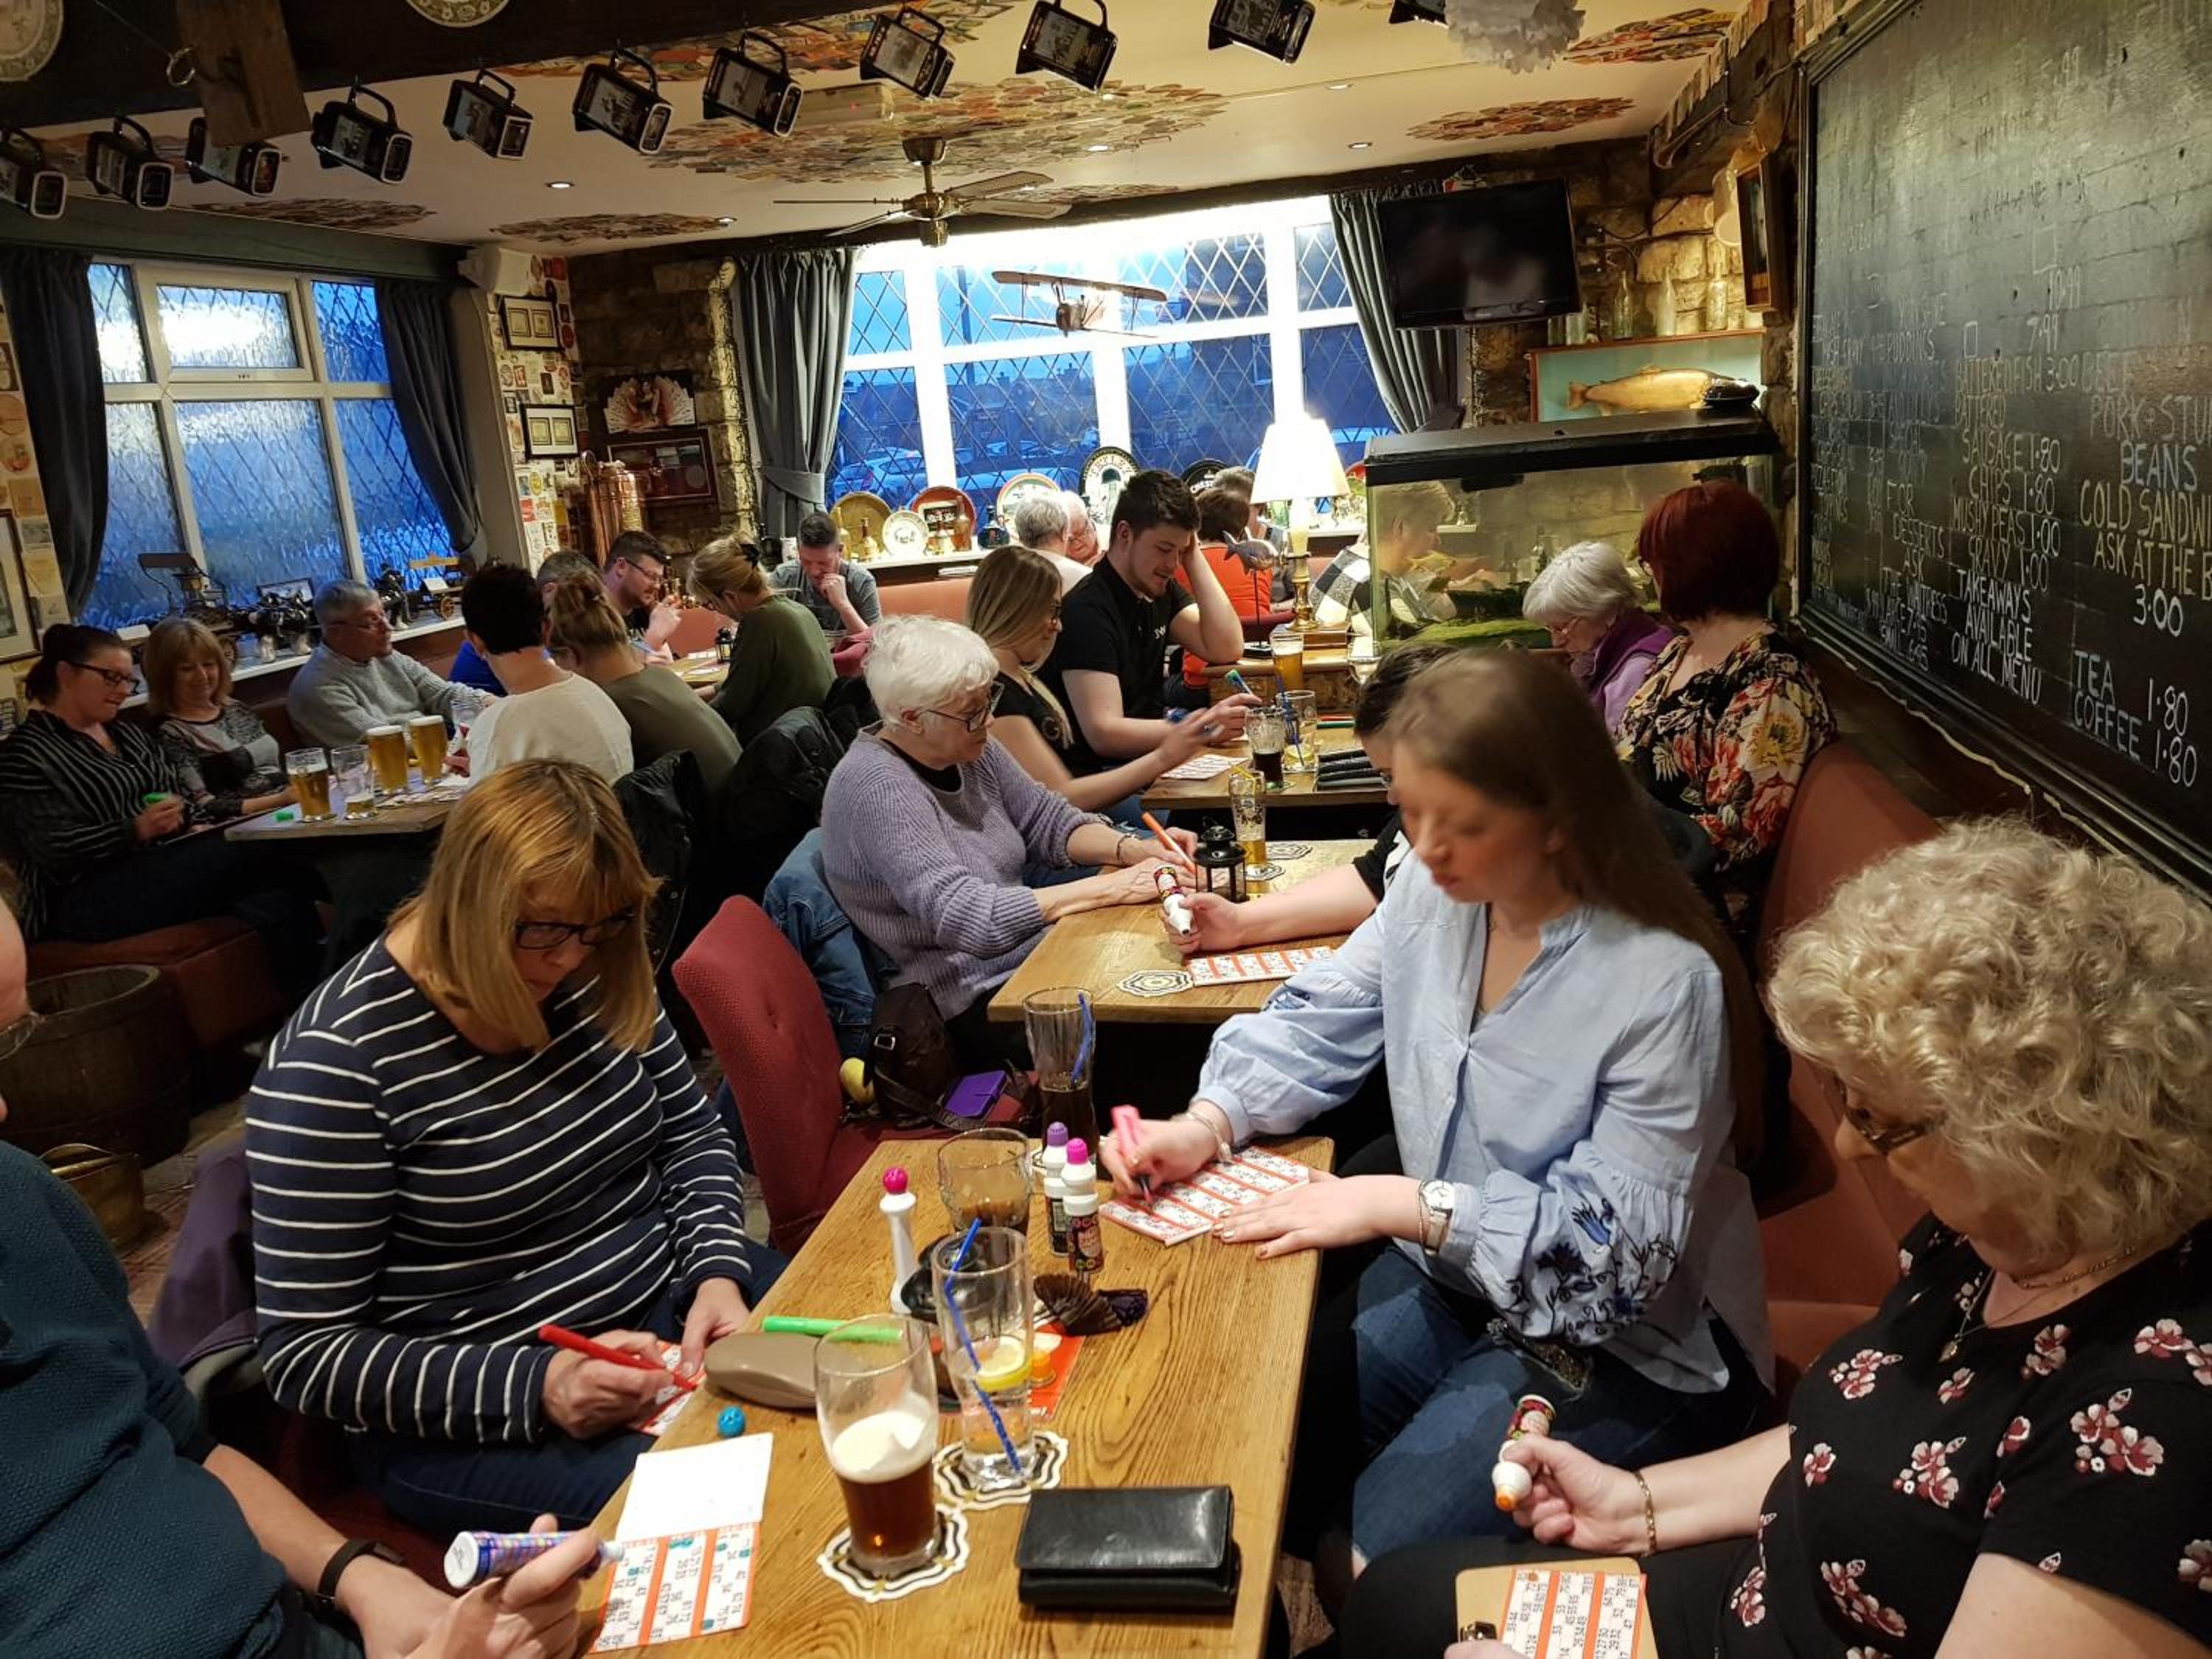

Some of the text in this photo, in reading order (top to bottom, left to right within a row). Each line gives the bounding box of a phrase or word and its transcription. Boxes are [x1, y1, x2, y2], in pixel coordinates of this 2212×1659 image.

[2045, 353, 2079, 392] 3.00
[1955, 392, 2007, 430] BATTERED
[2090, 392, 2146, 442] PORK
[1961, 427, 2024, 473] SAUSAGE
[2029, 434, 2062, 475] 1.80
[2120, 439, 2198, 493] BEANS
[1887, 479, 1915, 518] FOR
[1969, 464, 2011, 506] CHIPS
[2023, 472, 2055, 516] 1.80
[2079, 479, 2132, 533] COLD
[1953, 495, 2062, 558] MUSHY PEAS 1.00
[1903, 546, 1924, 582] ASK
[1968, 535, 2050, 593] GRAVY 1.00
[2093, 530, 2127, 577] ASK
[2131, 538, 2155, 588] AT
[2157, 540, 2197, 596] THE
[1956, 568, 2032, 625] TAKEAWAYS
[2133, 583, 2184, 637] 3.00
[1965, 602, 2034, 663] AVAILABLE
[1951, 630, 2042, 706] ON ALL MENU
[2074, 649, 2188, 737] TEA 1.80
[2074, 689, 2198, 787] COFFEE 1.80
